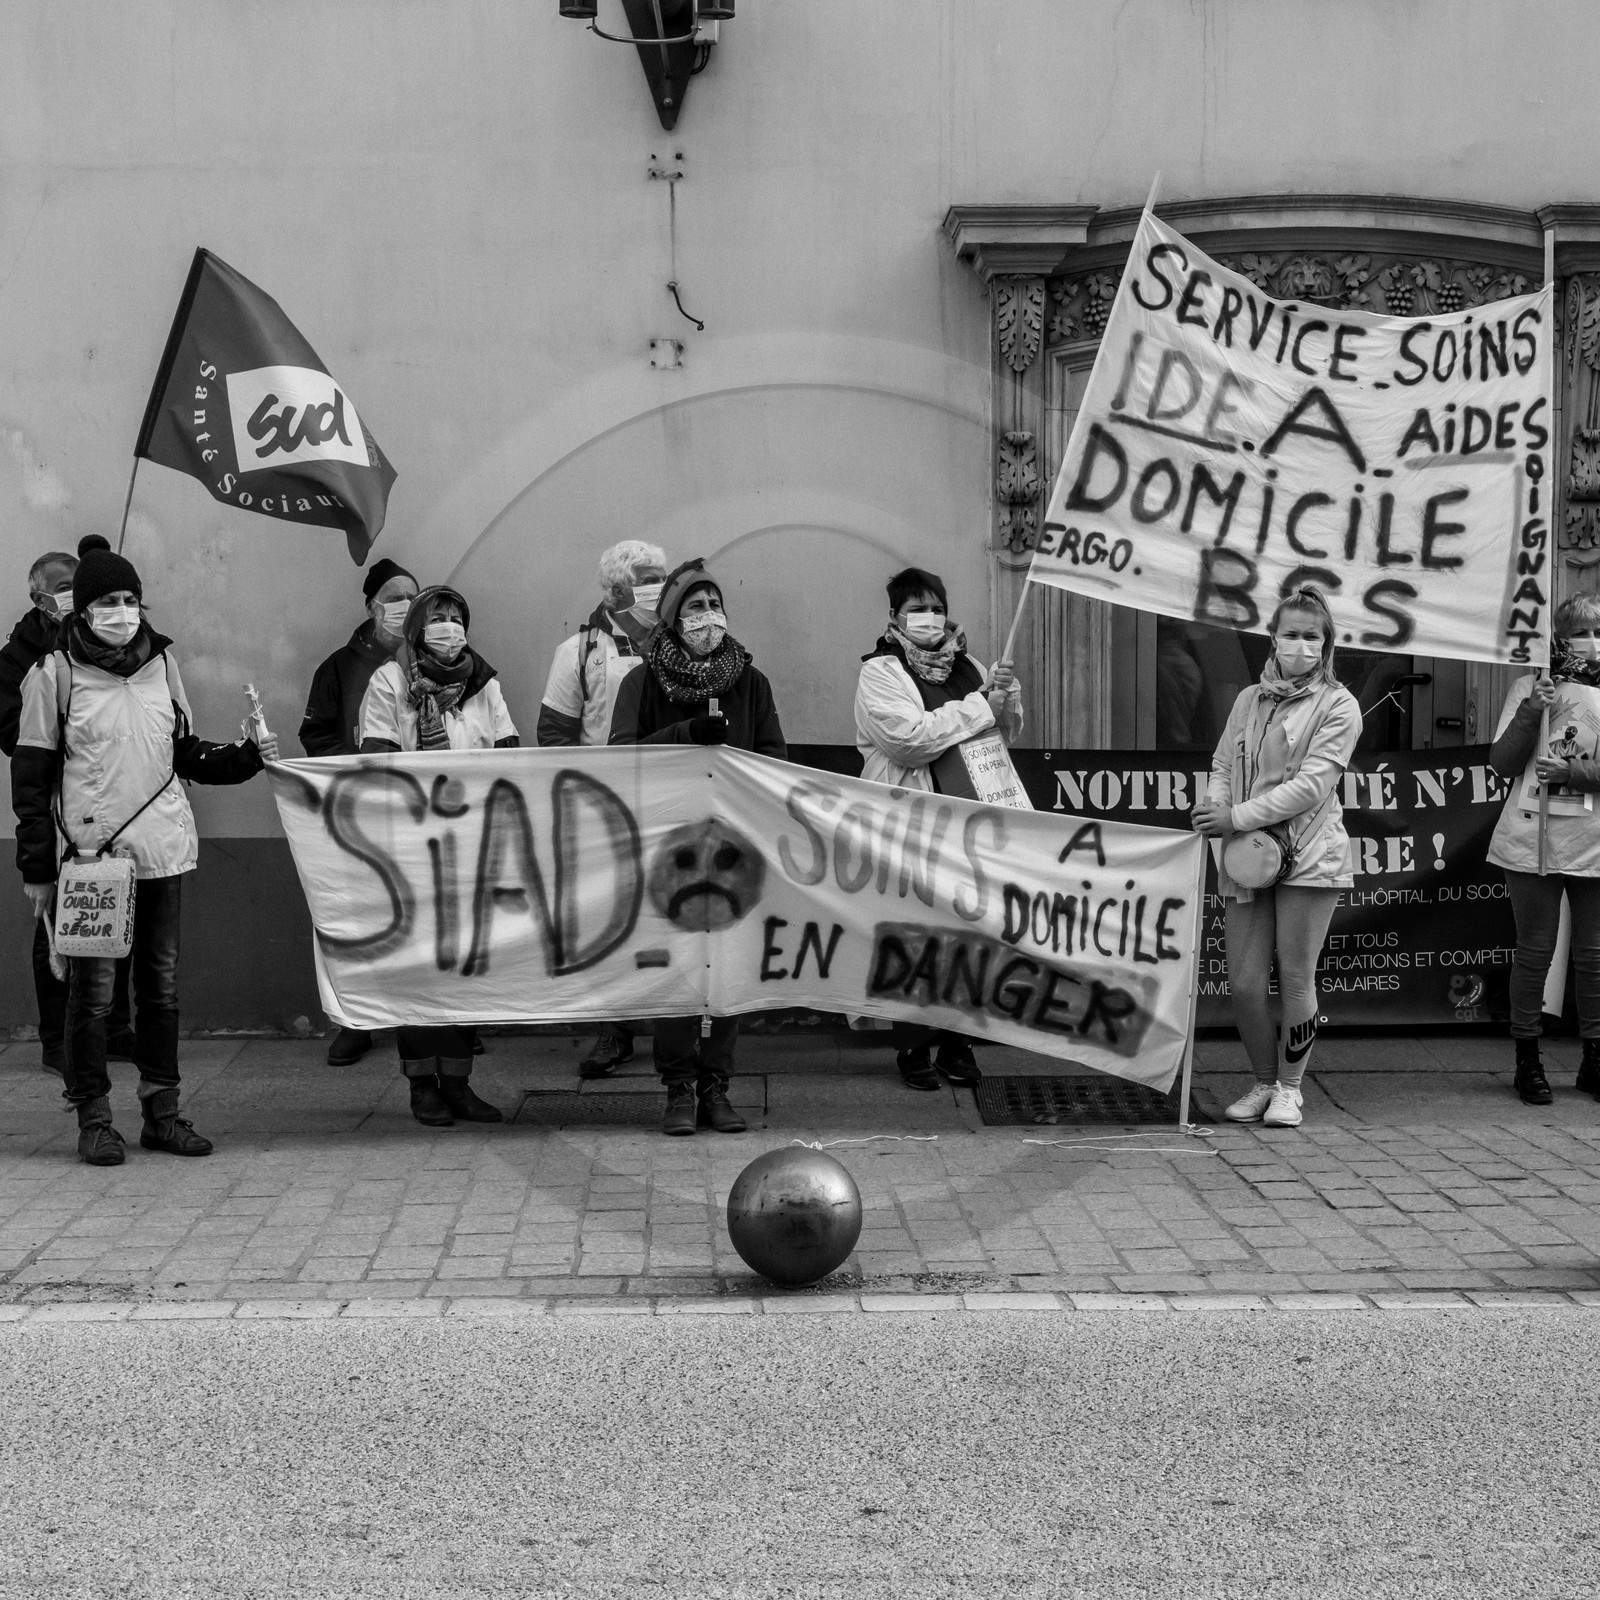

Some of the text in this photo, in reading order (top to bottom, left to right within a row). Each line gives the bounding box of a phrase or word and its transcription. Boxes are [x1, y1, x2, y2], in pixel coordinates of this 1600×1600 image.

[194, 360, 218, 463] Santé
[1058, 821, 1106, 866] A
[64, 880, 98, 894] LES
[1438, 886, 1462, 901] DU
[1466, 884, 1511, 900] SOCI
[74, 911, 100, 922] DU
[1330, 931, 1399, 950] ET TOUS
[1415, 951, 1435, 967] ET
[761, 916, 1137, 1044] EN DANGER
[1322, 975, 1400, 993] SALAIRES
